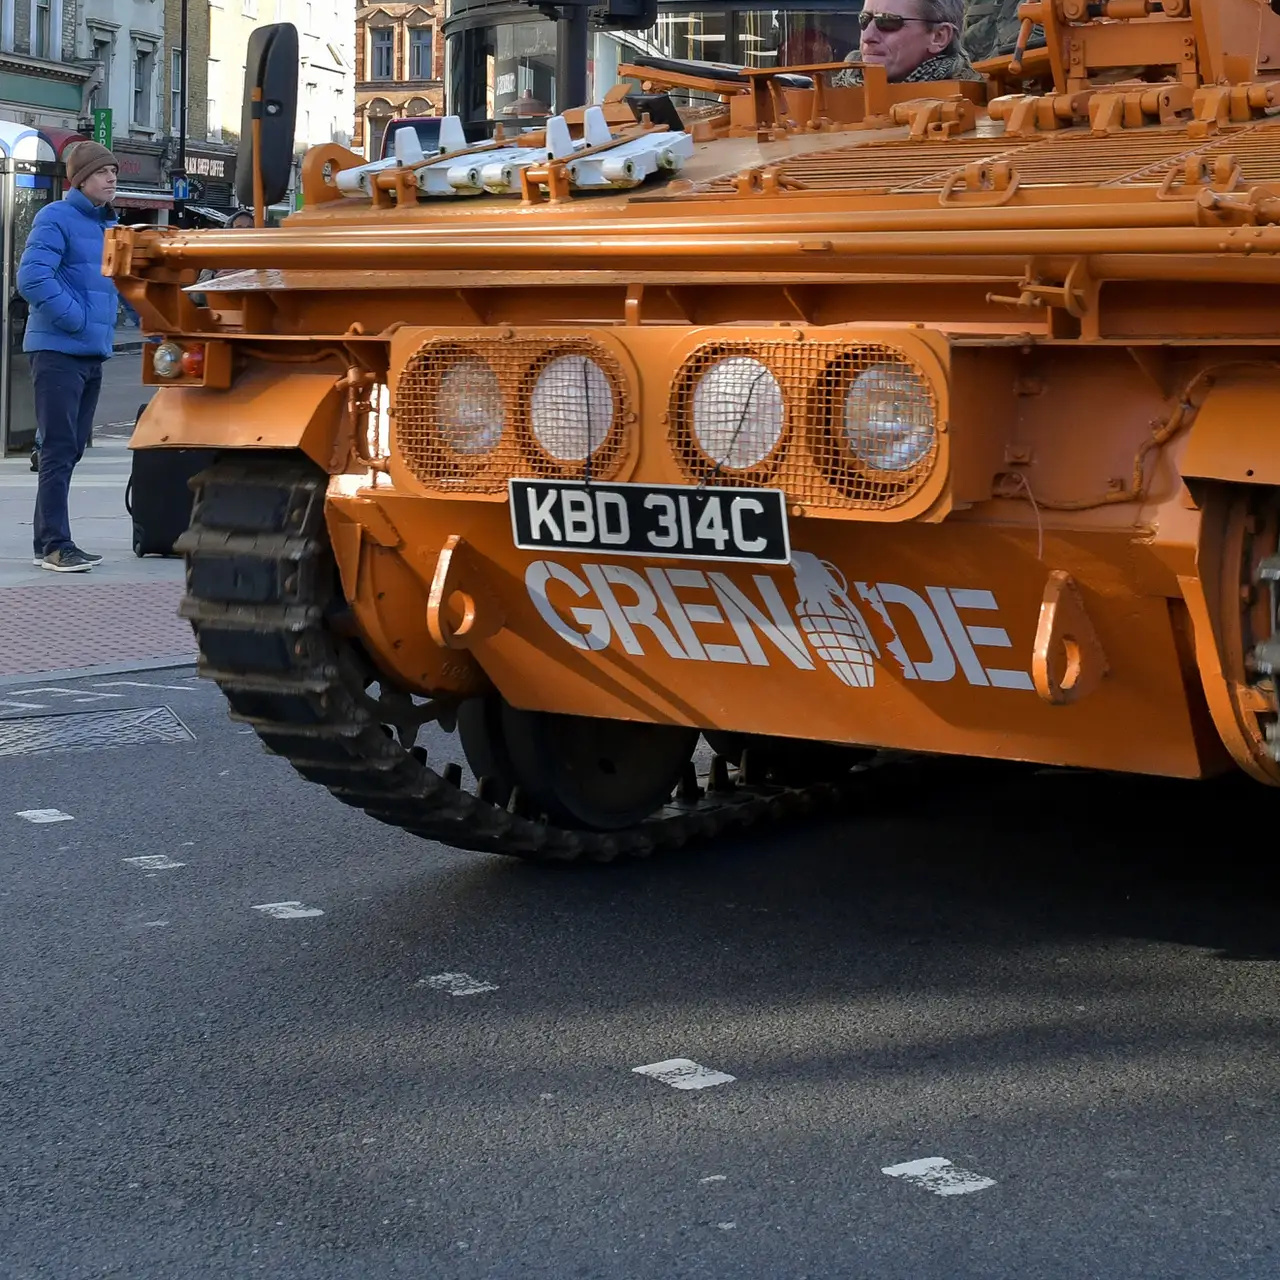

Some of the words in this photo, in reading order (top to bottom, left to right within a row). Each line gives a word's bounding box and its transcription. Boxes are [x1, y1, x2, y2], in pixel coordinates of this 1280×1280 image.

[99, 112, 107, 148] PADD
[210, 160, 224, 177] COFFEE
[527, 488, 629, 544] KBD
[643, 494, 767, 553] 314C
